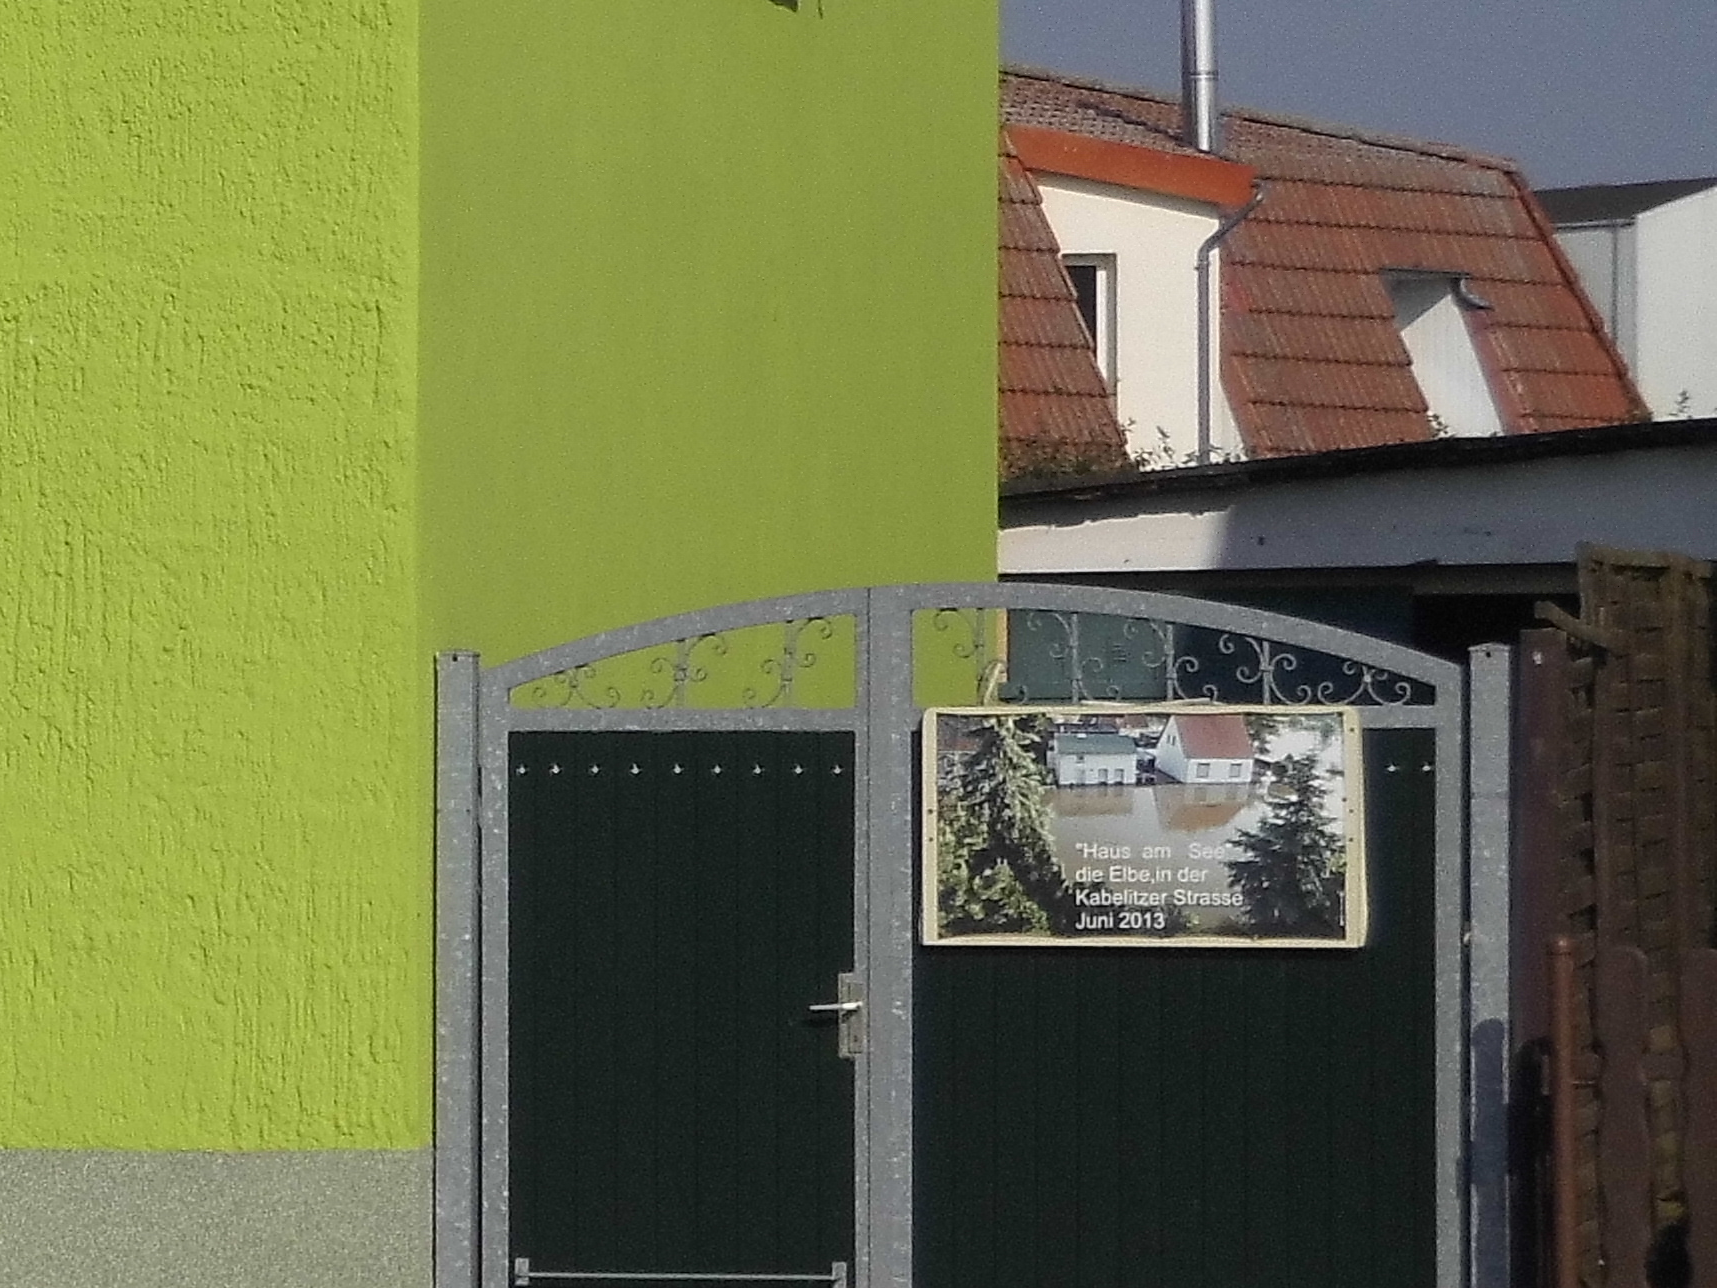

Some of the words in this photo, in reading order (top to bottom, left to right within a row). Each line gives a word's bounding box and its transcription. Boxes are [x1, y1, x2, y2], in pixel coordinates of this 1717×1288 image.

[1142, 845, 1171, 859] am
[1075, 866, 1103, 882] die
[1177, 866, 1208, 882] der
[1075, 889, 1167, 906] Kabelitzer
[1173, 889, 1243, 906] Strasse
[1075, 912, 1114, 930] Juni
[1118, 912, 1166, 929] 2013
